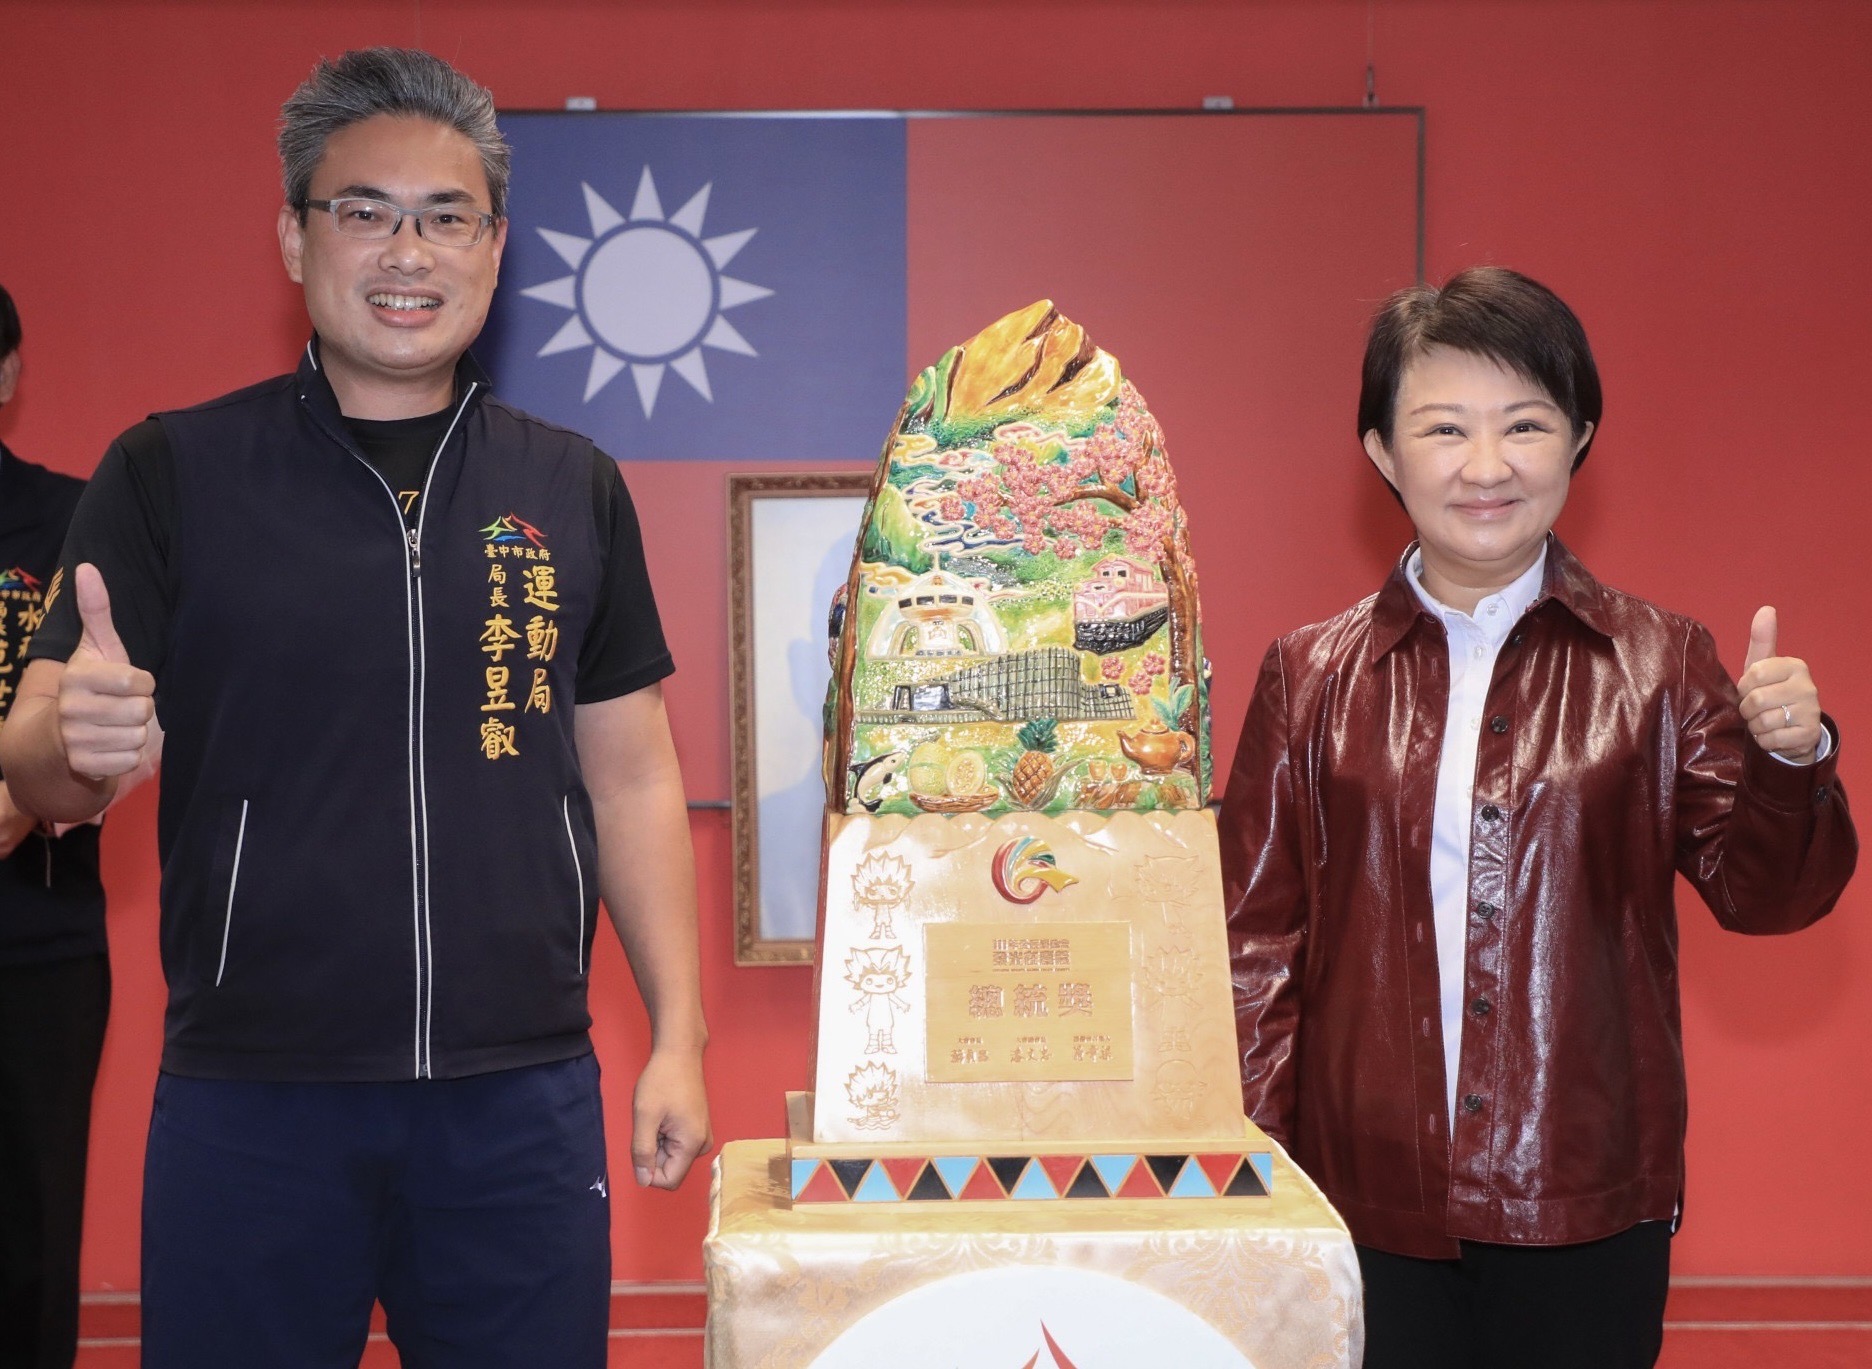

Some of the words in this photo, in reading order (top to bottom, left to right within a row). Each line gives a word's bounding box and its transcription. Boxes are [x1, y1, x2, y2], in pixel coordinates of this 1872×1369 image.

[484, 544, 551, 562] 臺中市政府
[523, 565, 560, 714] 運動局
